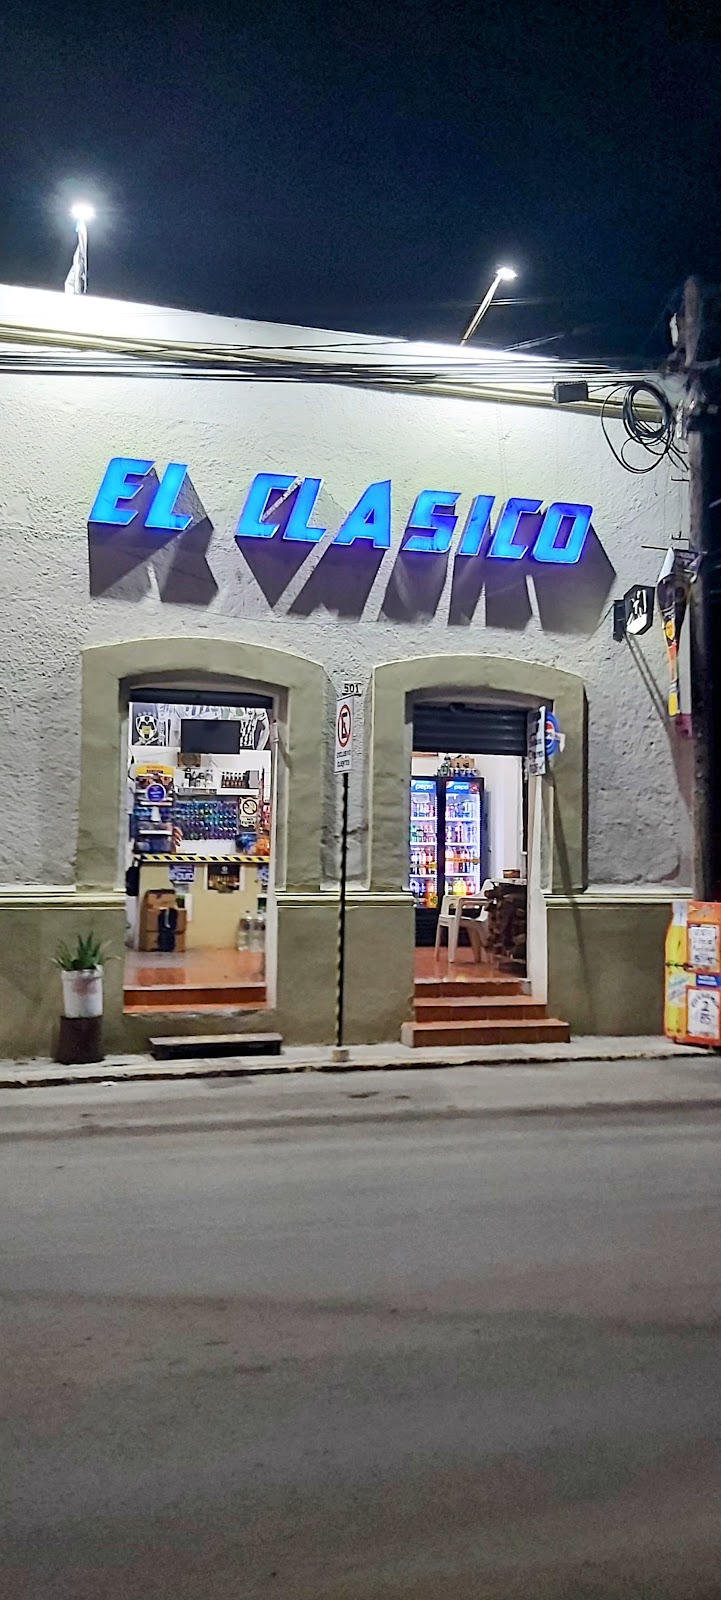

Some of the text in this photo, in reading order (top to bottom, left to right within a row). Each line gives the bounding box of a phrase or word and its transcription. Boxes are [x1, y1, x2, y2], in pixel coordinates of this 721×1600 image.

[88, 457, 594, 564] EL CLASICO
[344, 684, 359, 693] 501
[415, 783, 433, 791] pepsi
